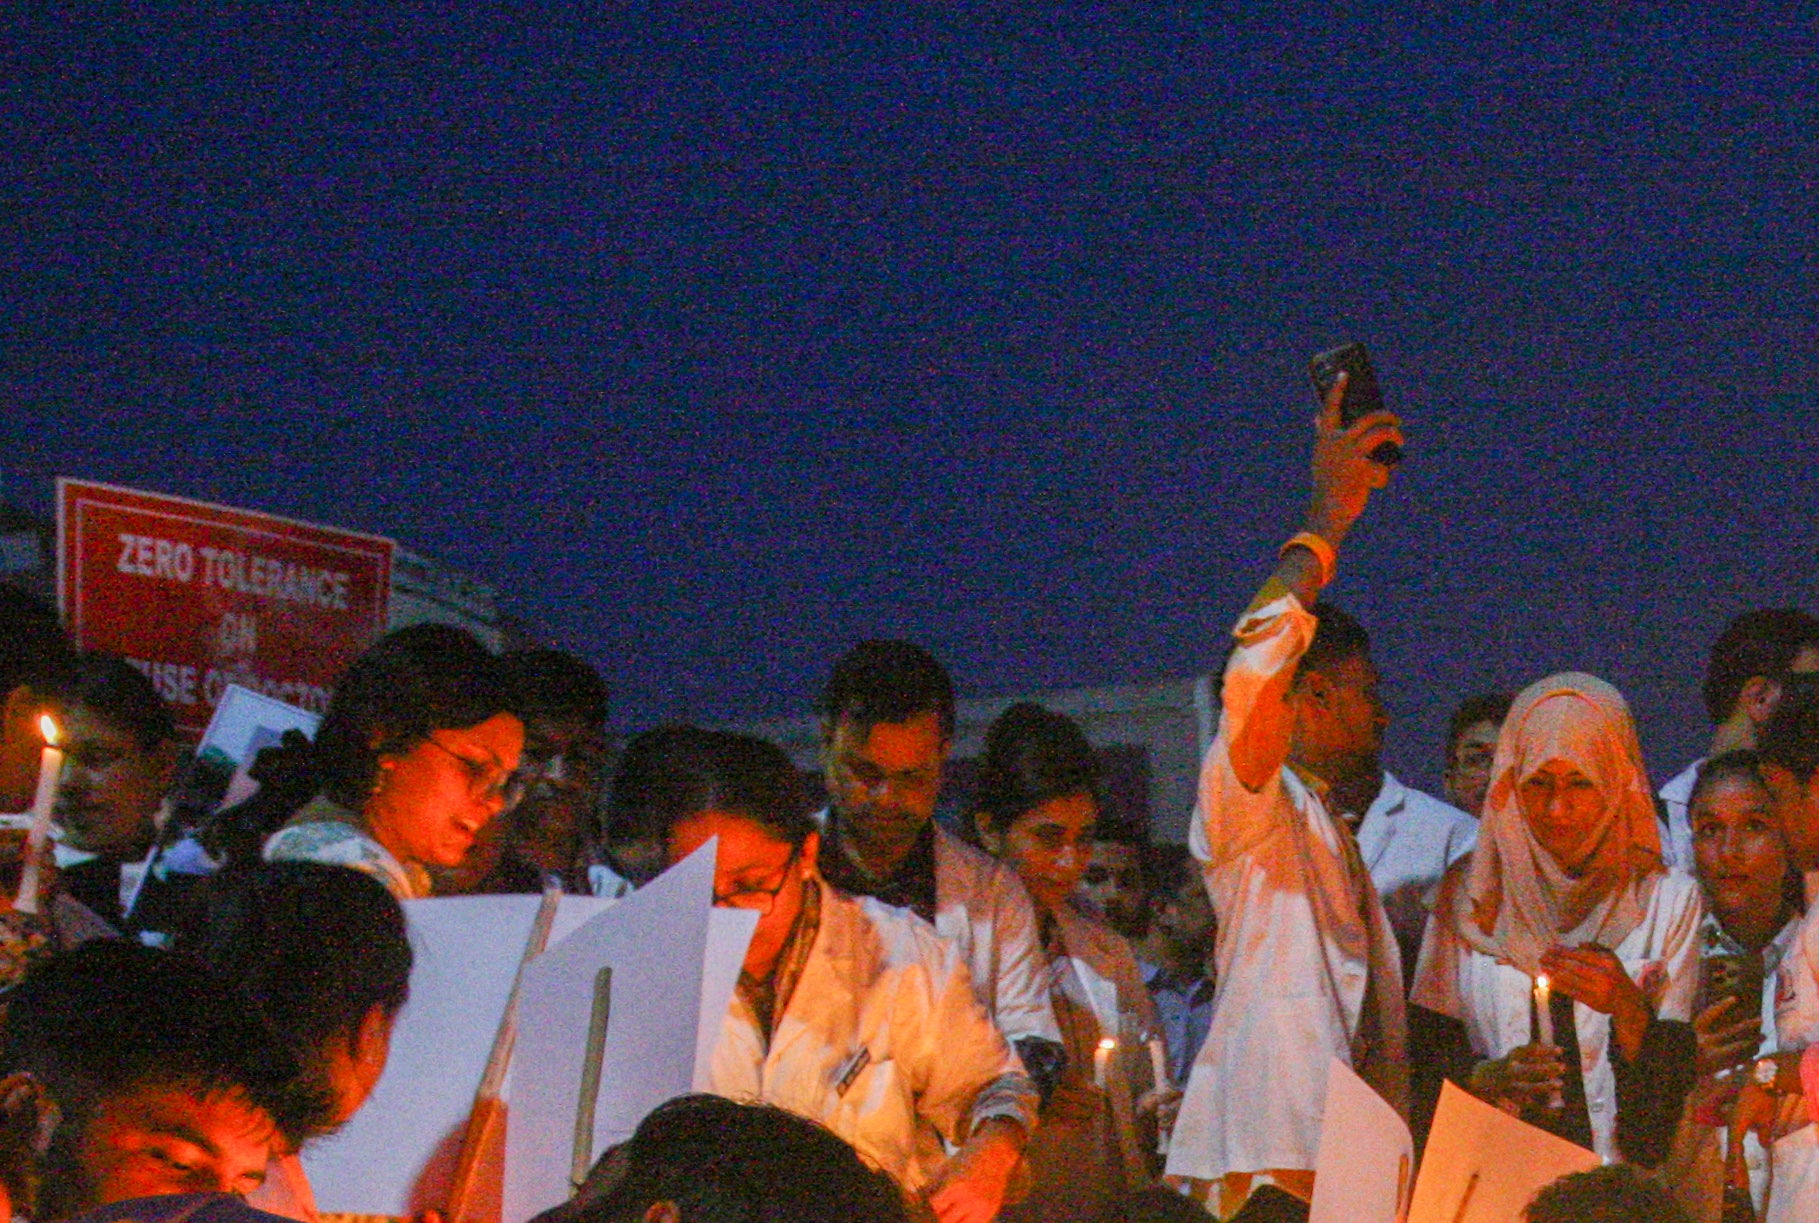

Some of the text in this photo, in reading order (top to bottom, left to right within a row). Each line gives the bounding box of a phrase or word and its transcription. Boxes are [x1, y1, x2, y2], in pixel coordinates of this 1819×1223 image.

[117, 533, 350, 610] ZERO TOLERANCE
[125, 657, 197, 704] USE
